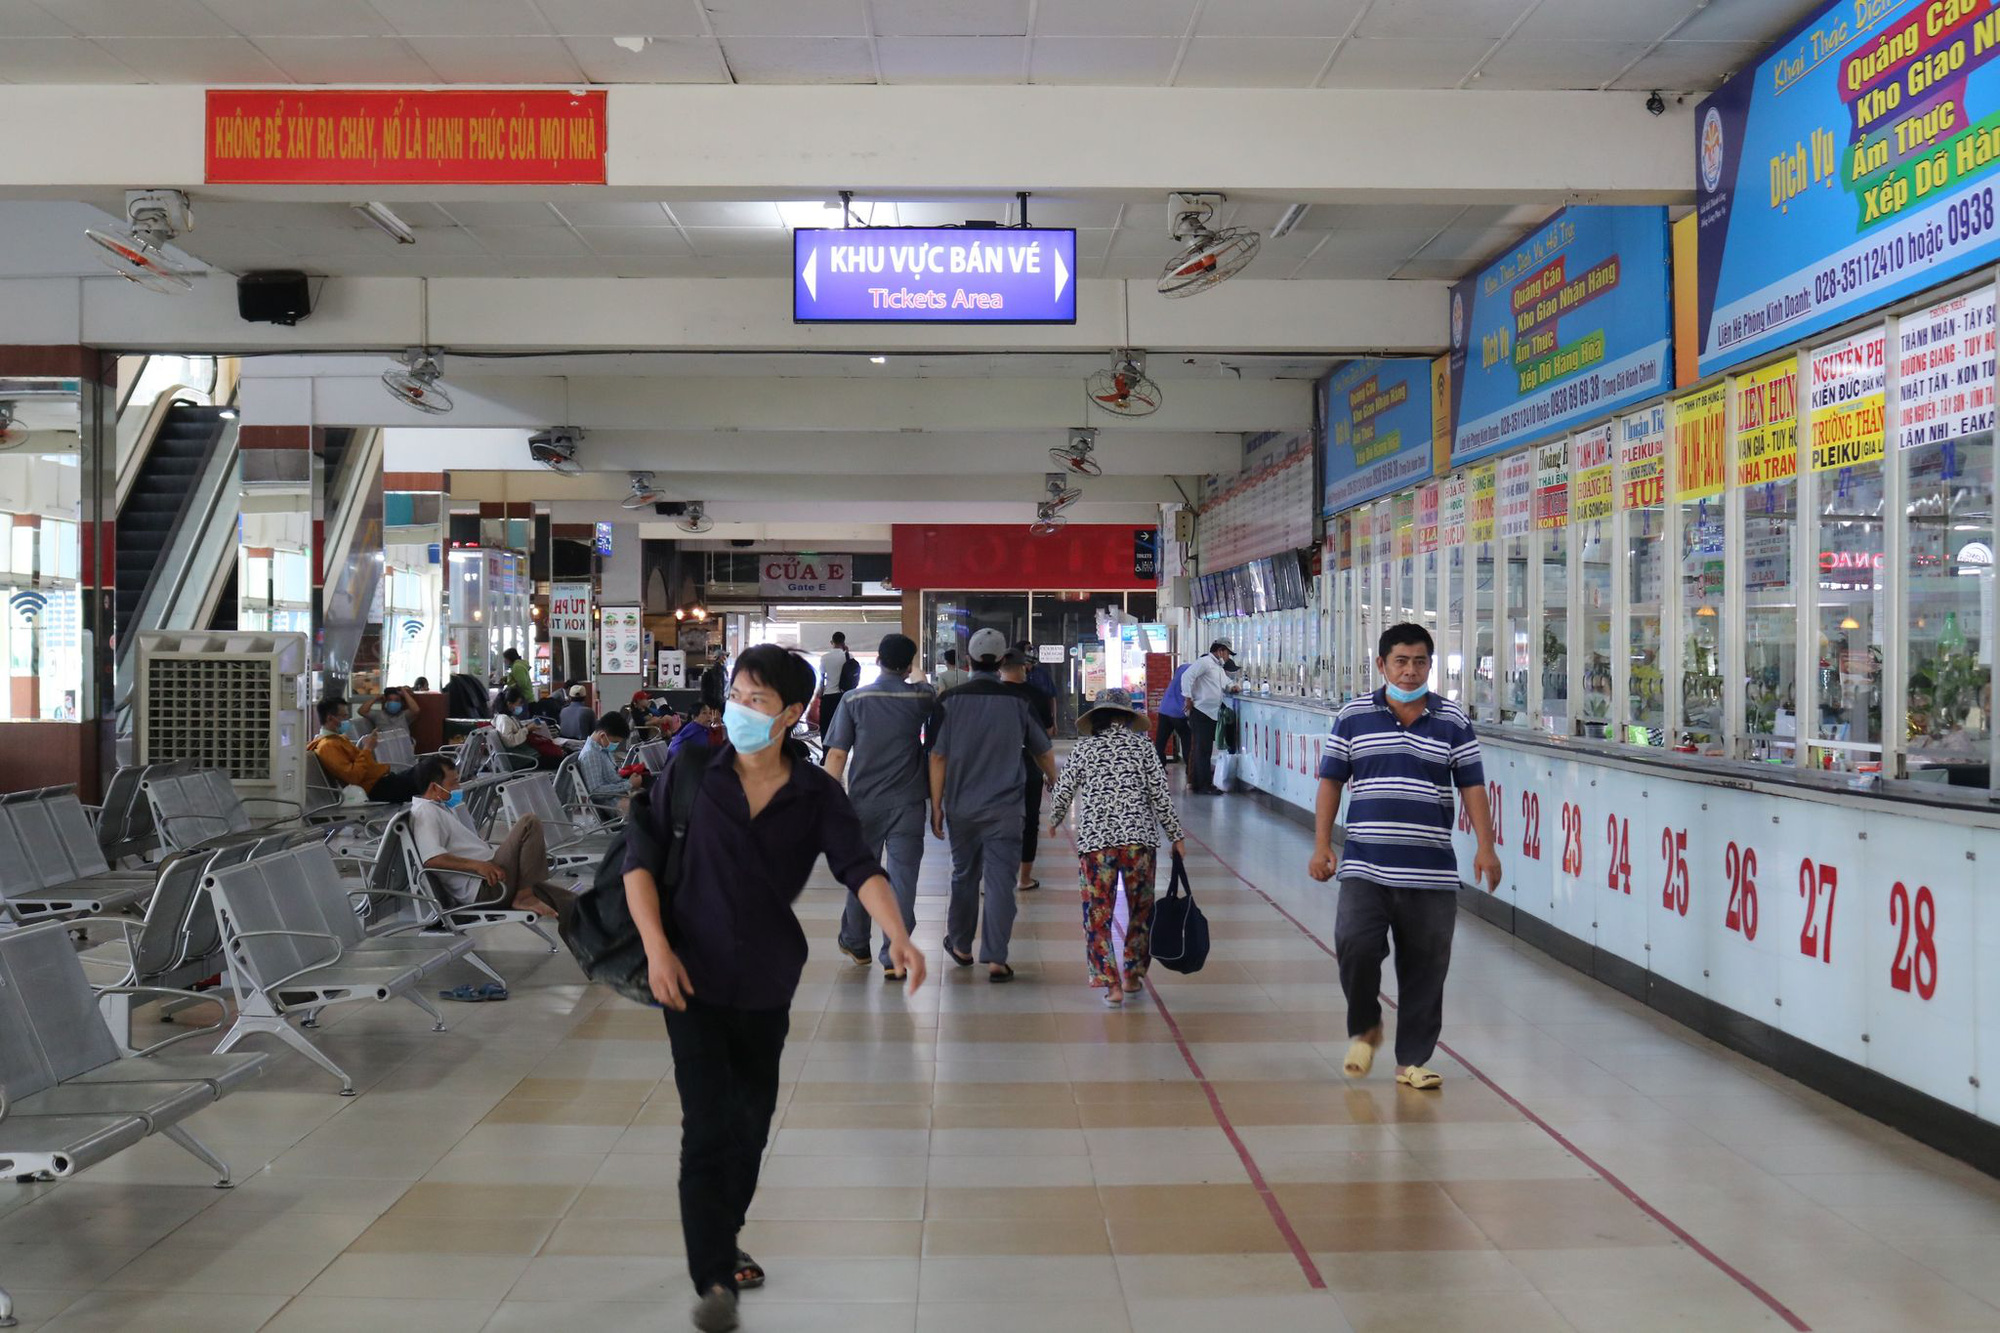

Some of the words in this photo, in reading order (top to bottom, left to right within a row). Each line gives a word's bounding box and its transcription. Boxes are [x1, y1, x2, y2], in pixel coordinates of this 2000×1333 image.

[1847, 22, 1919, 91] Quảng
[1857, 82, 1900, 129] Kho
[1908, 40, 1965, 97] Giao
[216, 109, 261, 159] KHÔNG
[265, 99, 283, 158] ĐỂ
[287, 103, 313, 158] XẢY
[318, 117, 335, 158] RA
[383, 98, 403, 159] NỔ
[405, 107, 421, 159] LÀ
[427, 117, 463, 167] HẠNH
[469, 108, 504, 160] PHÚC
[510, 102, 535, 160] CỦA
[540, 117, 565, 168] MỌI
[570, 108, 596, 160] NHÀ
[1852, 133, 1888, 182] Ẩm
[1894, 100, 1955, 155] Thực
[1770, 140, 1807, 214] Dịch
[1811, 127, 1834, 188] Vụ
[1864, 170, 1908, 224] Xếp
[831, 246, 884, 273] KHU
[890, 242, 944, 280] VỰC
[951, 241, 1002, 273] BÁN
[1008, 241, 1040, 273] VÉ
[1815, 237, 1903, 304] 028-35112410
[1909, 220, 1944, 264] hoặc
[1948, 187, 1994, 246] 0938
[868, 288, 946, 309] Tickets
[952, 289, 1003, 309] Area
[1514, 279, 1541, 309] Quảng
[1544, 266, 1561, 290] Cáo
[1517, 309, 1534, 333] Kho
[1536, 300, 1557, 323] Giao
[1559, 283, 1586, 310] Nhận
[1588, 262, 1616, 292] Hàng
[1531, 331, 1554, 357] Thực
[1901, 328, 1928, 352] THÀNH
[1931, 317, 1955, 342] NHÂN
[1964, 308, 1982, 331] TÂY
[1930, 343, 1955, 368] GIANG
[1964, 335, 1982, 358] TUY
[1554, 348, 1578, 377] Hàng
[1901, 379, 1924, 402] NHẬT
[1928, 372, 1948, 393] TÂN
[1957, 363, 1978, 386] KON
[1551, 388, 1567, 416] 0938
[1569, 383, 1578, 410] 69
[1580, 378, 1589, 406] 69
[1590, 374, 1600, 401] 38
[1738, 375, 1765, 431] LIÊN
[1769, 368, 1797, 422] HƯN
[1812, 382, 1836, 408] KIẾN
[1839, 376, 1860, 401] ĐỨC
[1772, 428, 1786, 452] TUY
[1812, 412, 1852, 446] TRƯỜNG
[1900, 428, 1924, 448] LÂM
[1929, 422, 1948, 441] NHI
[1622, 442, 1654, 463] PLEIKU
[1738, 461, 1761, 485] NHA
[1764, 453, 1796, 479] TRAN
[1812, 440, 1860, 469] PLEIKU
[1622, 468, 1664, 510] HUẾ
[1538, 517, 1554, 529] KON
[765, 557, 818, 580] CỬA
[827, 564, 844, 580] E
[788, 583, 815, 591] Gate
[819, 583, 826, 591] E
[1489, 780, 1504, 846] 21
[1522, 790, 1540, 860] 22
[1562, 802, 1583, 878] 23
[1607, 813, 1631, 895] 24
[1662, 826, 1689, 916] 25
[1725, 841, 1758, 941] 26
[1799, 857, 1837, 964] 27
[1889, 881, 1937, 1001] 28
